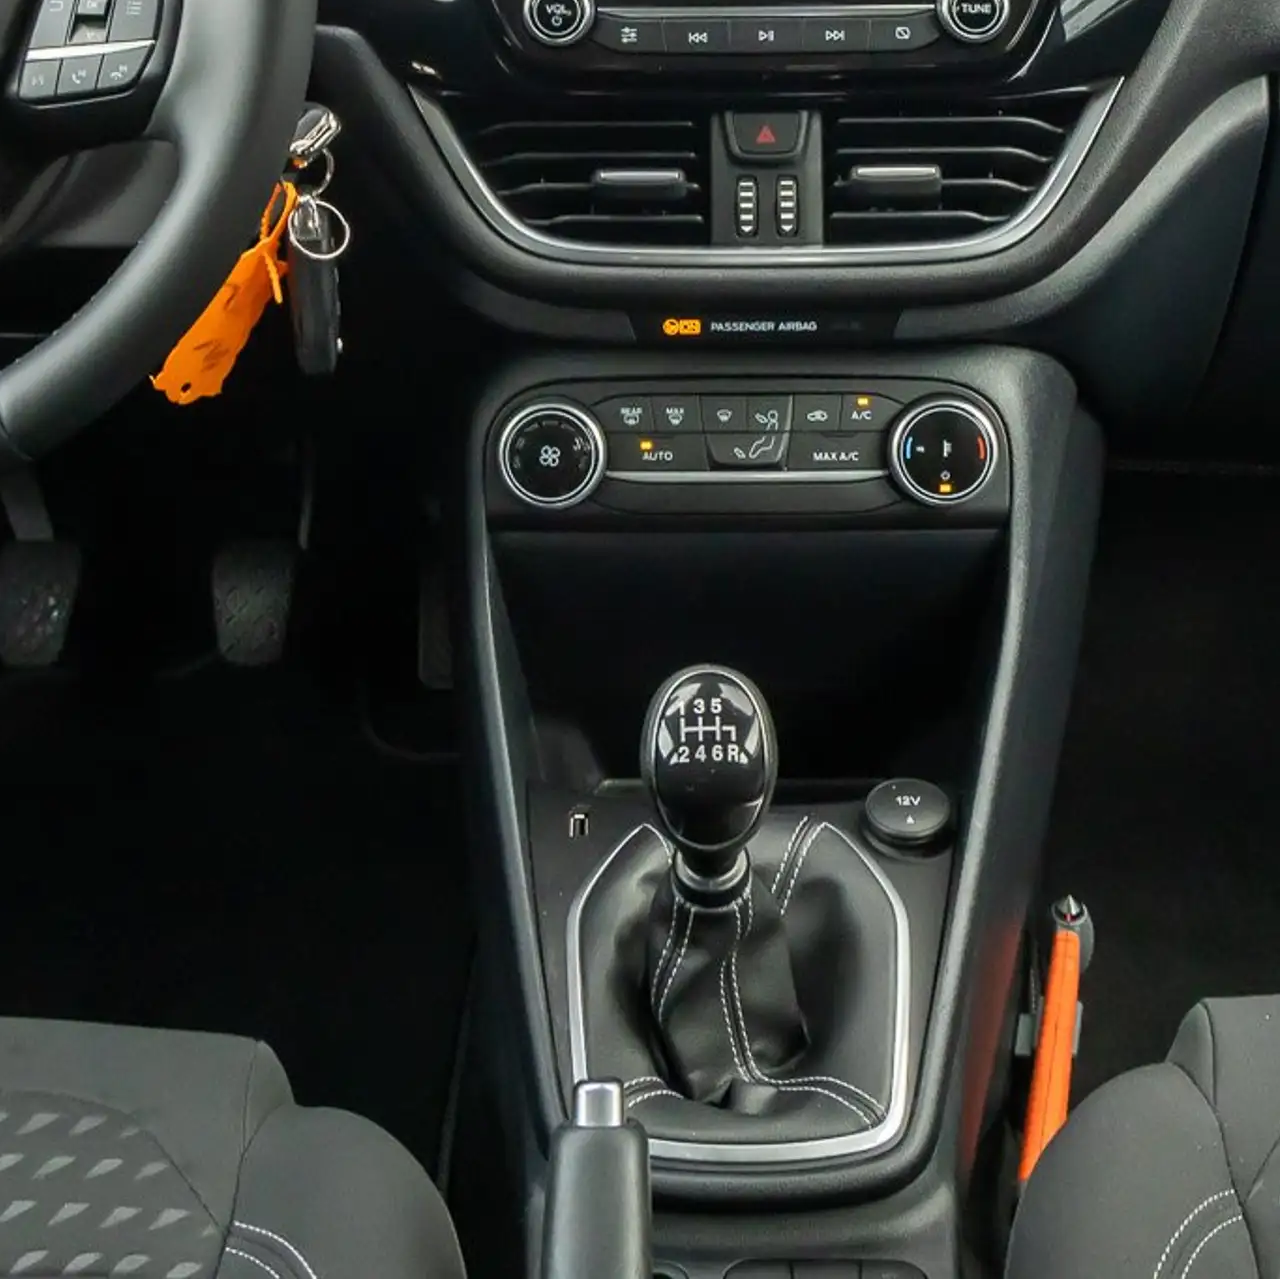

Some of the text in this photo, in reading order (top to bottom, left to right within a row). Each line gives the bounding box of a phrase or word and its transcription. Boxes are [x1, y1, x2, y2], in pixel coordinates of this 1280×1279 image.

[960, 2, 992, 15] TUNE
[709, 321, 818, 332] PASSENGER AIRBAG
[621, 407, 643, 416] REAR
[666, 407, 685, 416] MAX
[851, 410, 872, 420] A/C
[642, 451, 674, 462] AUTO
[813, 451, 859, 462] MAX A/C
[693, 697, 706, 714] 3
[710, 697, 723, 714] 5
[678, 744, 740, 763] 2 4 6 R
[895, 794, 921, 807] 12V
